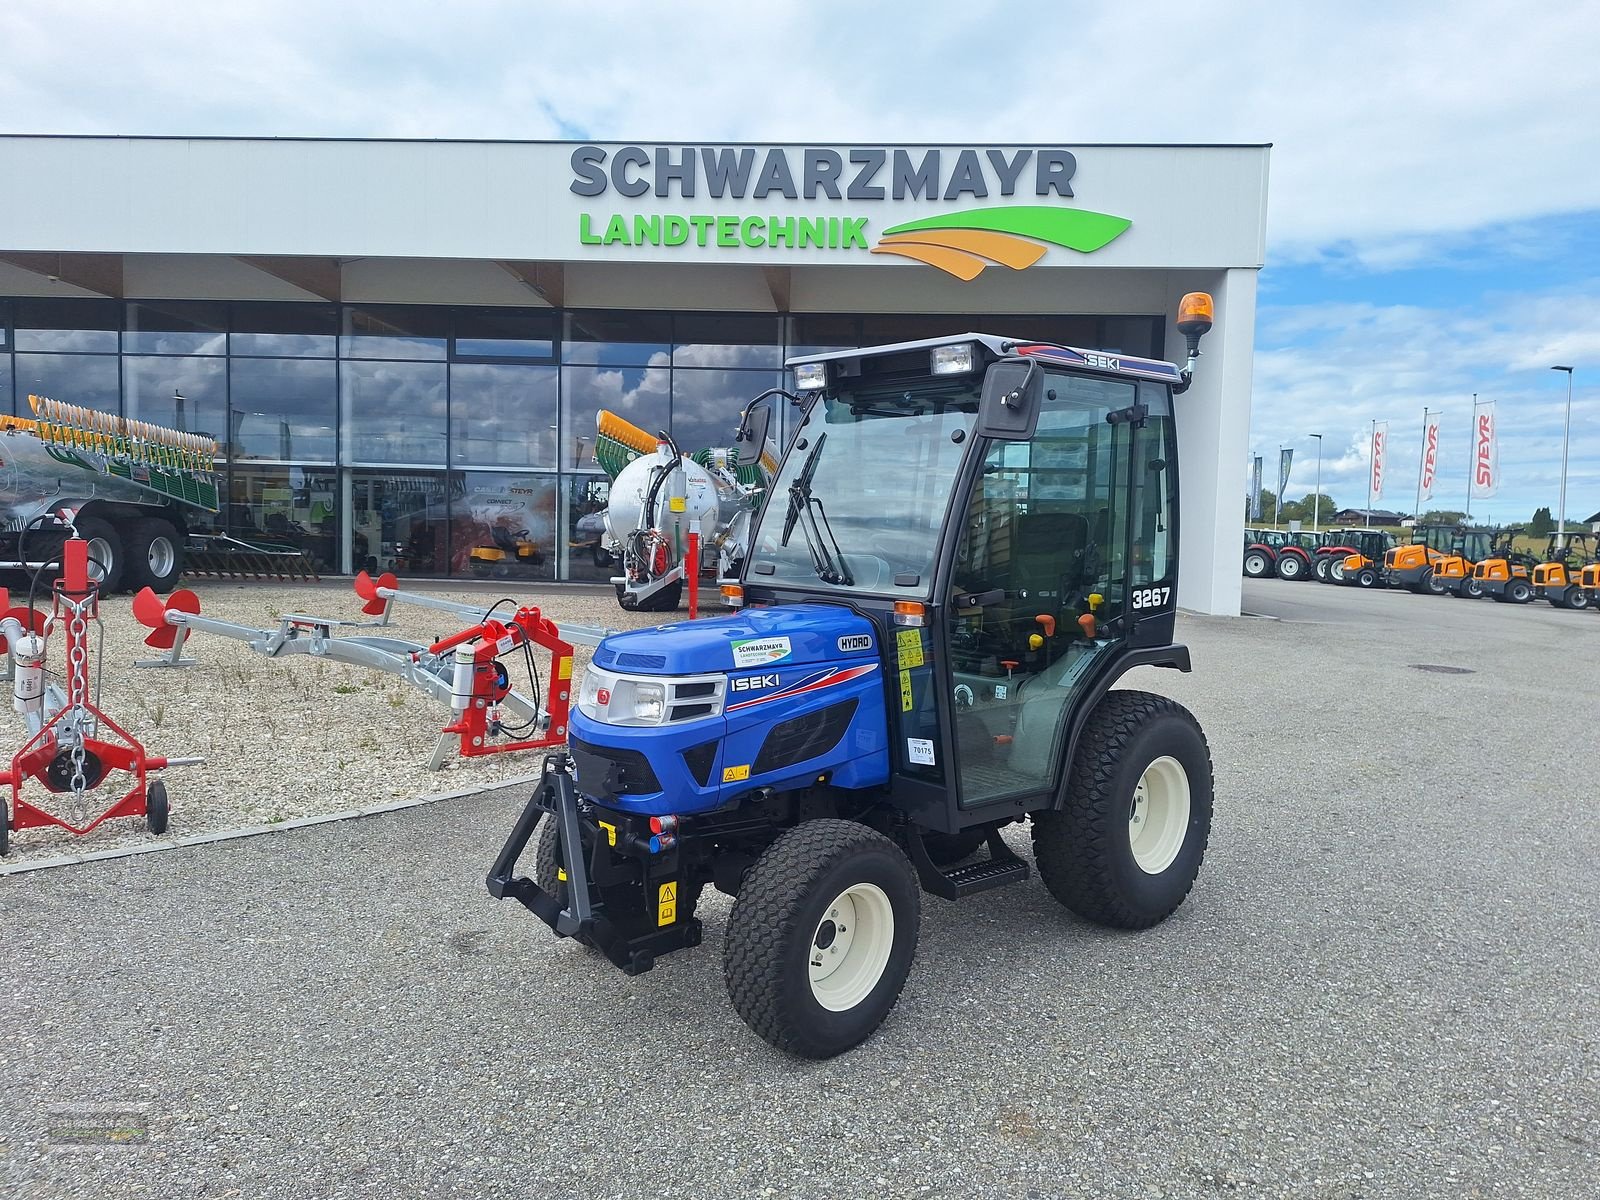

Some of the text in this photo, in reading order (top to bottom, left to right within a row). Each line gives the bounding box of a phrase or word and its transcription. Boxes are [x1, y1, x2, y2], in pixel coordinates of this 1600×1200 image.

[569, 146, 1077, 200] SCHWARZMAYR
[579, 213, 868, 249] LANDTECHNIK
[1083, 353, 1120, 370] ISEKI
[1373, 431, 1382, 492] STEYR
[1423, 424, 1438, 489] STEYR
[1476, 414, 1491, 488] STEYR
[1132, 586, 1171, 609] 3267
[738, 643, 783, 653] SCHWARZMAYR
[841, 636, 869, 650] HYDRO
[731, 673, 780, 691] ISEKI
[913, 746, 932, 755] 70175
